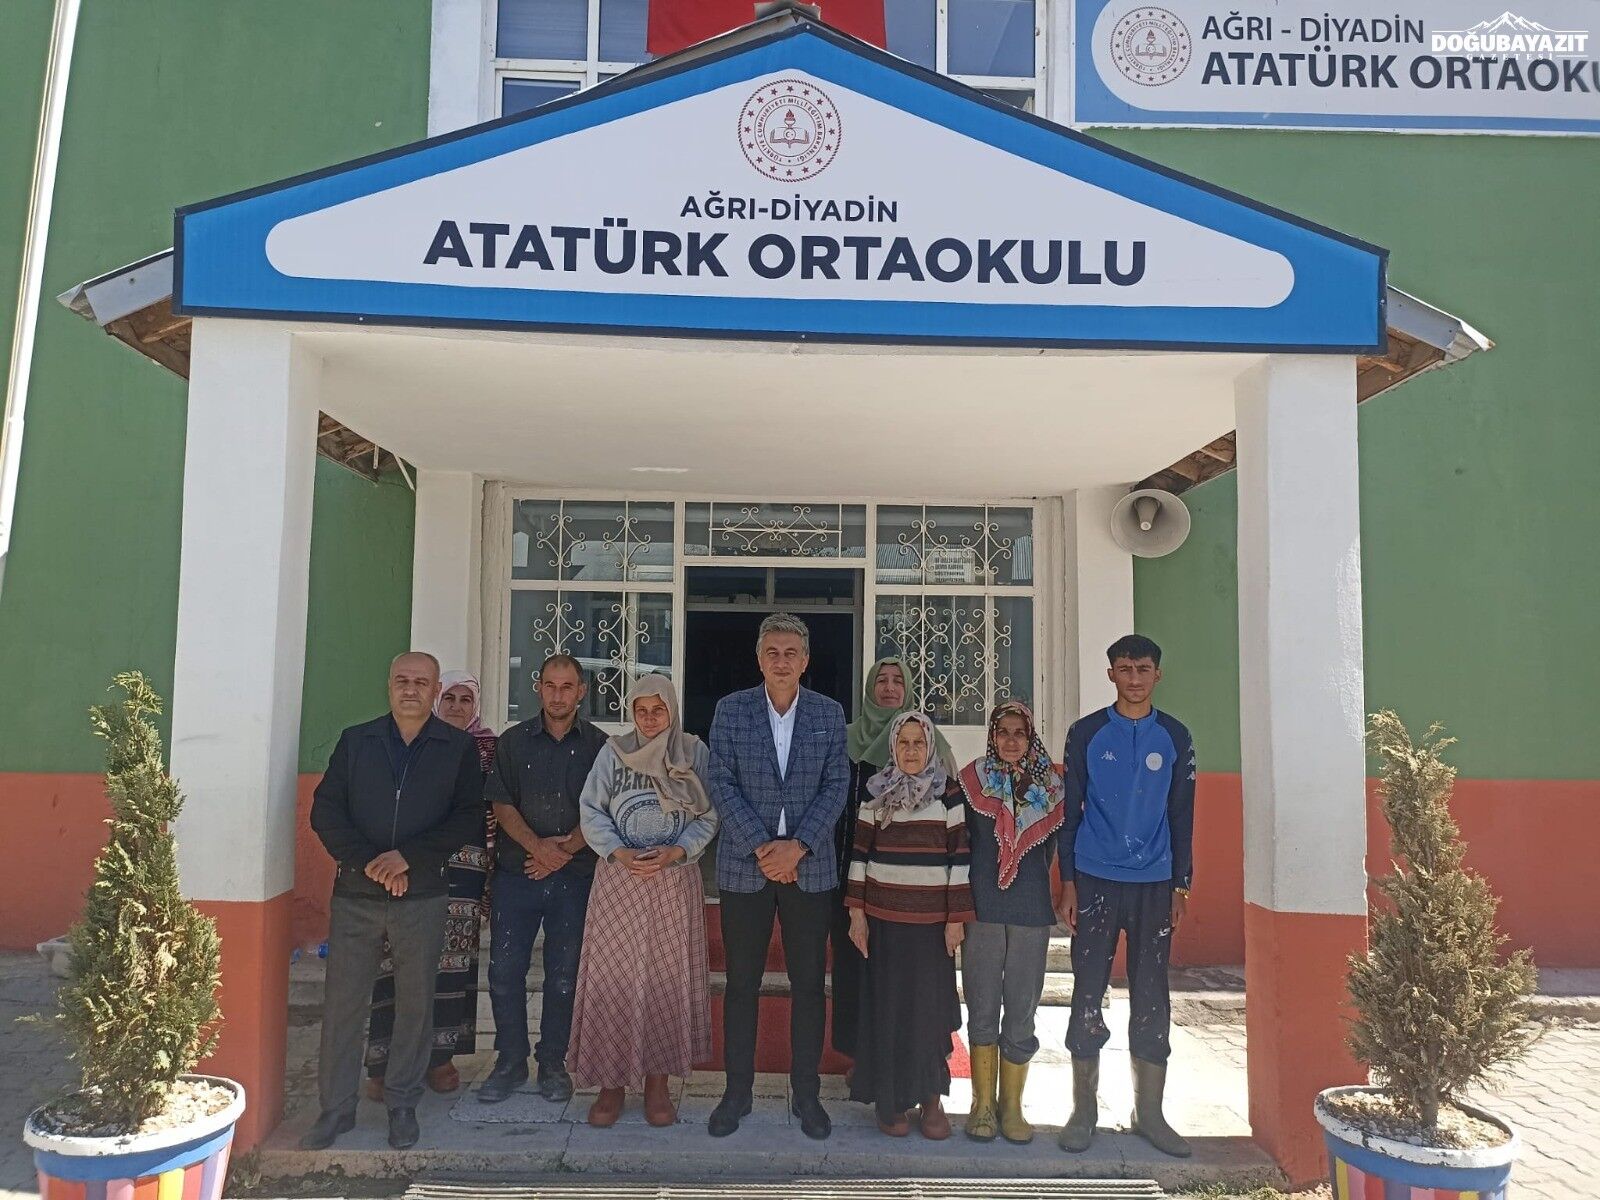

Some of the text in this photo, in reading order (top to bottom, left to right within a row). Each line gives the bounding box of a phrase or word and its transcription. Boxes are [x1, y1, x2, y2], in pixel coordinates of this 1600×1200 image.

[1202, 10, 1272, 41] AĞRI
[1301, 13, 1424, 43] DİYADİN
[1201, 45, 1399, 88] ATATÜRK
[680, 190, 898, 222] AĞRI-DİYADİN
[423, 217, 1146, 286] ATATÜRK ORTAOKULU
